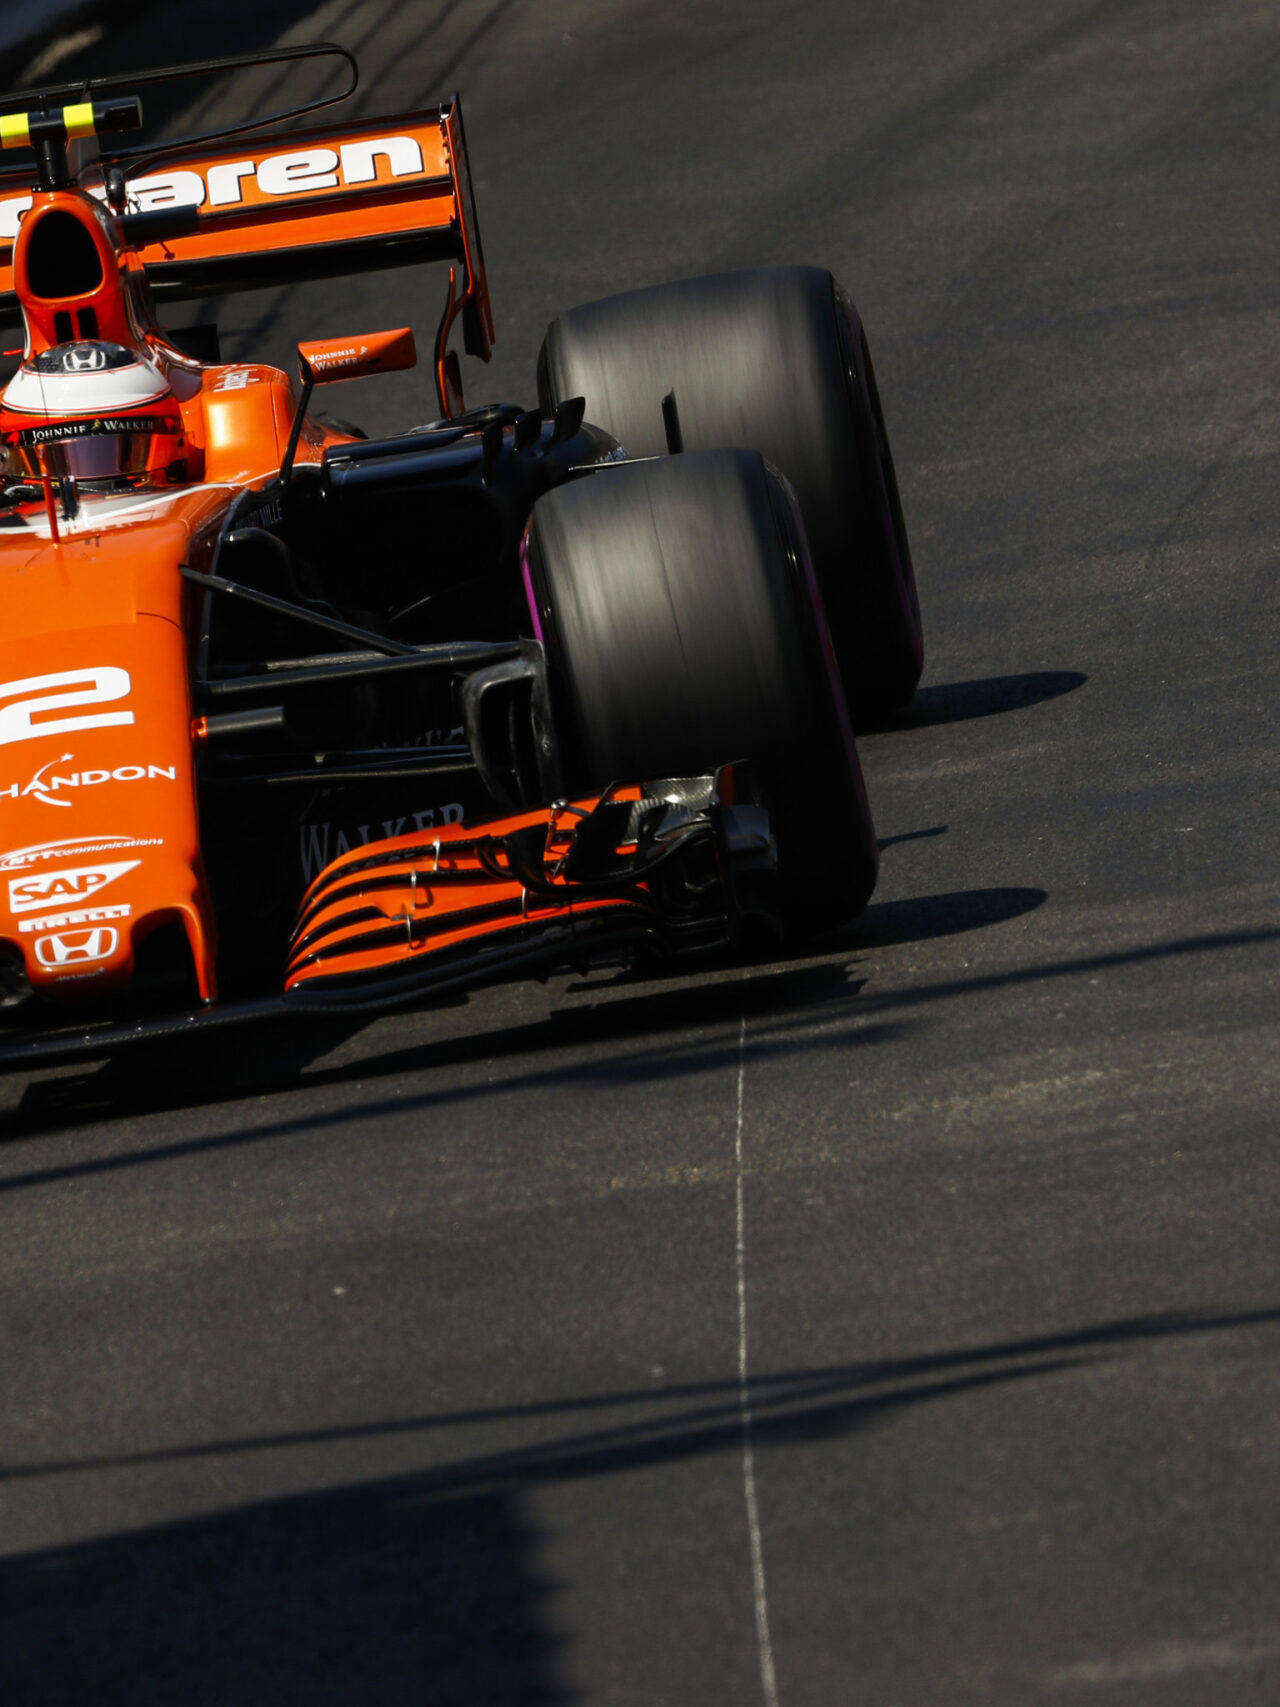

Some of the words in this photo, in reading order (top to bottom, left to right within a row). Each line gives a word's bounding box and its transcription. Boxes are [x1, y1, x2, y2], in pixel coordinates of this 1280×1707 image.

[308, 348, 356, 364] JOHNNIE
[314, 357, 358, 371] WALKER
[32, 425, 86, 444] JOHNNIE
[104, 419, 154, 432] WALKER
[13, 873, 108, 905] SAP
[18, 904, 131, 933] PIRELLI
